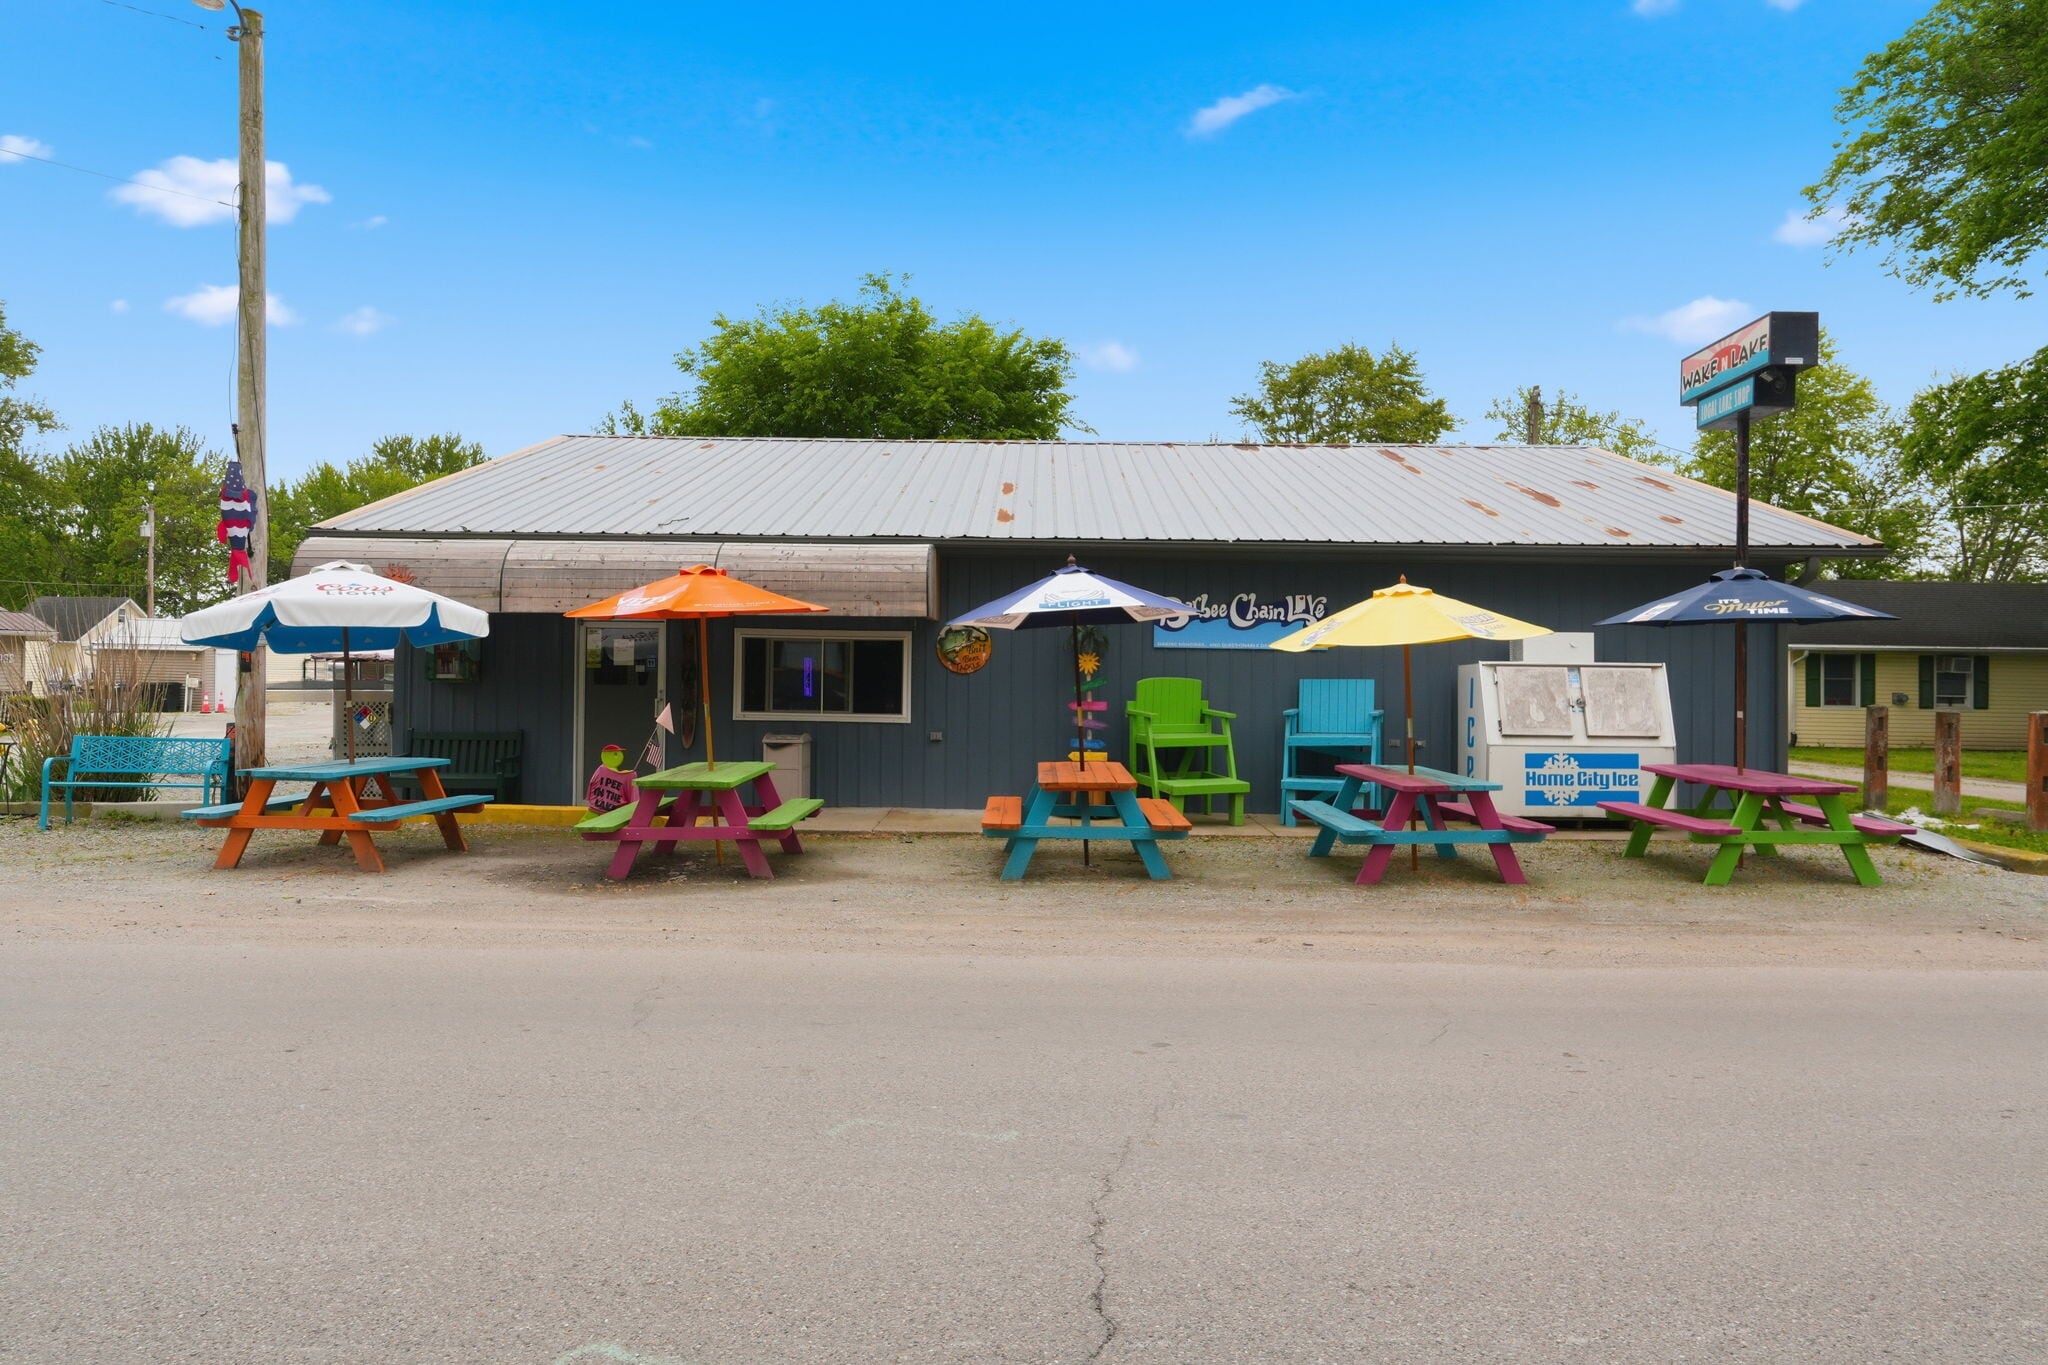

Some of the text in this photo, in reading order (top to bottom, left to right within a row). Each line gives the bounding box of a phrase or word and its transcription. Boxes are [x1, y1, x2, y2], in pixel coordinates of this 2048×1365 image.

[1683, 359, 1718, 391] WAKE
[1731, 333, 1768, 369] LAKE
[316, 583, 395, 592] Coors
[1229, 592, 1286, 628] Chain
[1703, 599, 1789, 615] Miller
[1747, 607, 1790, 615] TIME
[600, 777, 623, 791] I PEE
[1525, 771, 1639, 790] Home City Ice
[606, 790, 623, 803] THE
